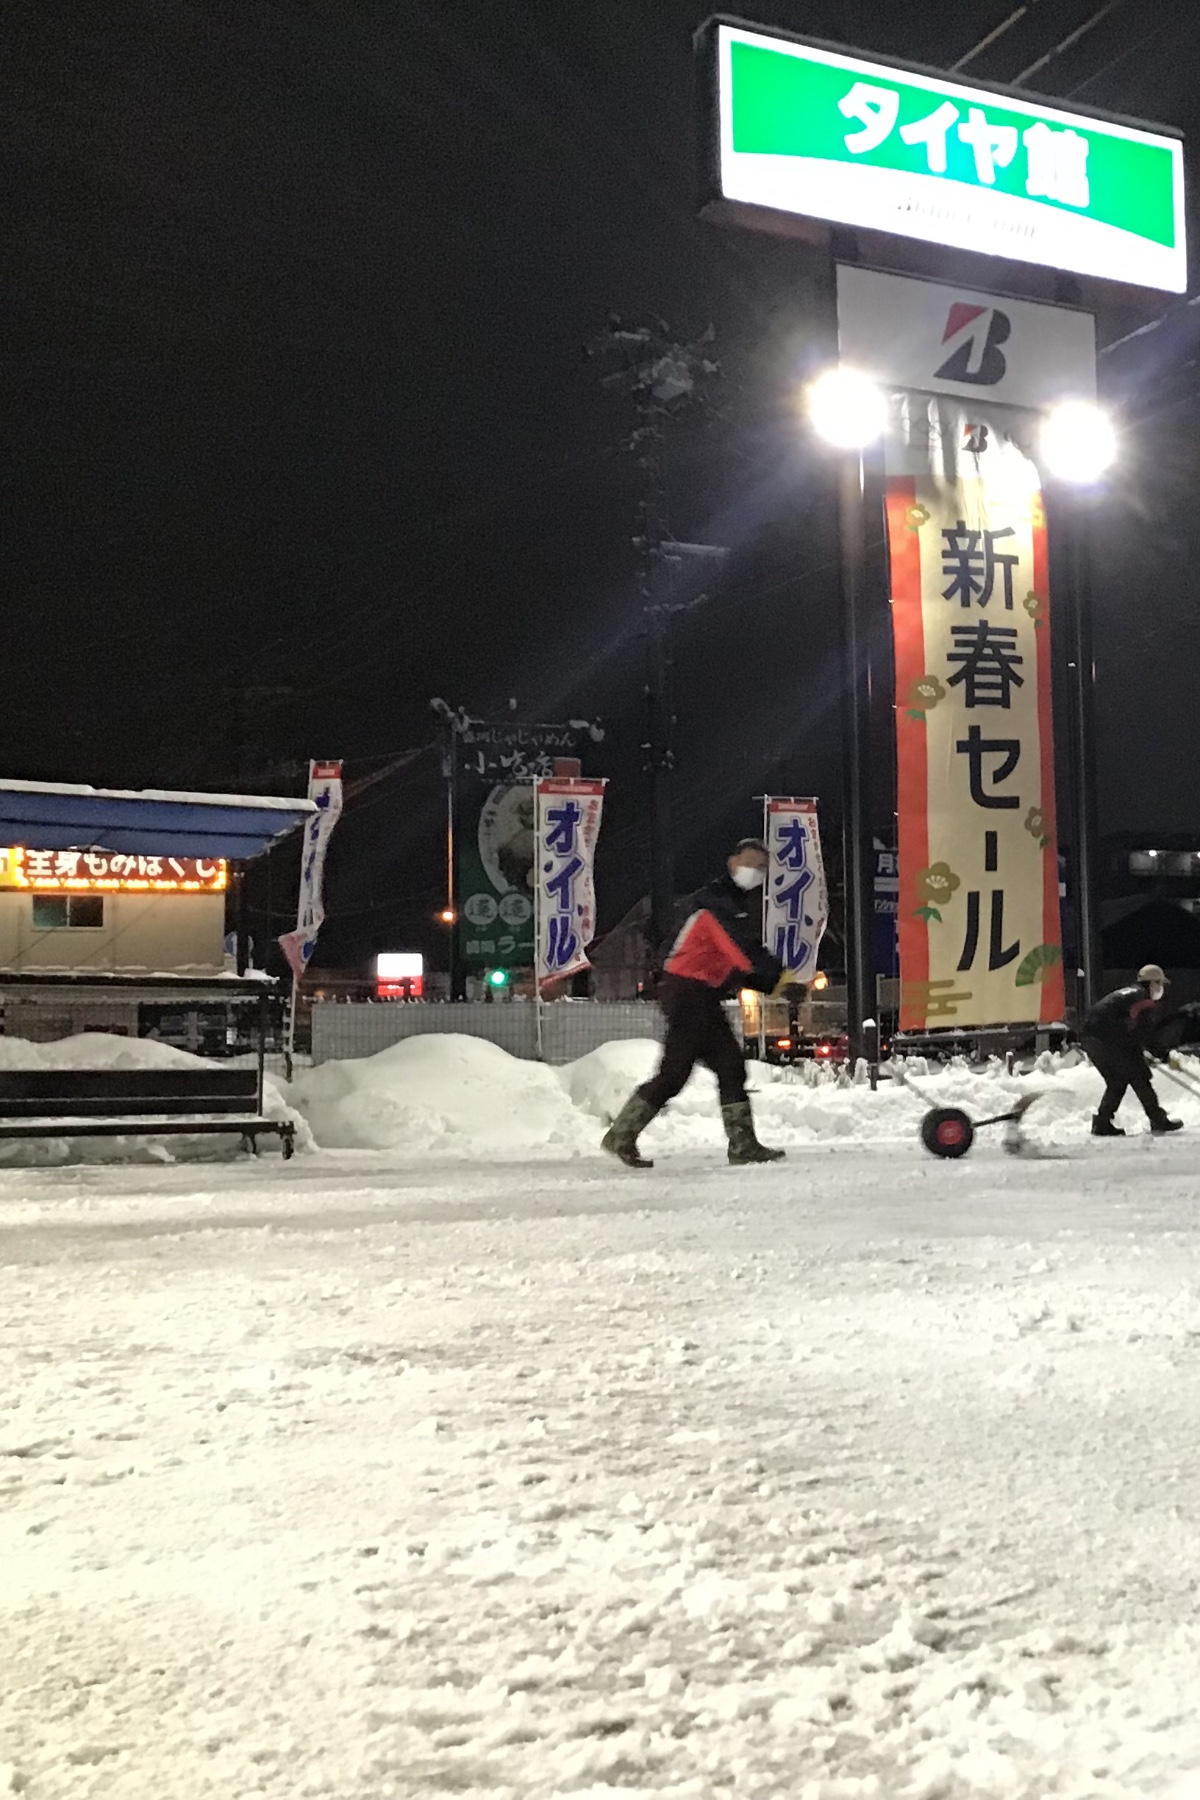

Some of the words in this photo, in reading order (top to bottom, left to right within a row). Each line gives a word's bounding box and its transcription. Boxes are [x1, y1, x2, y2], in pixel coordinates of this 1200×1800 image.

[837, 81, 1090, 209] タイヤ館
[941, 519, 1025, 972] 新春セール
[544, 801, 585, 969] オイル
[774, 817, 815, 971] オイル
